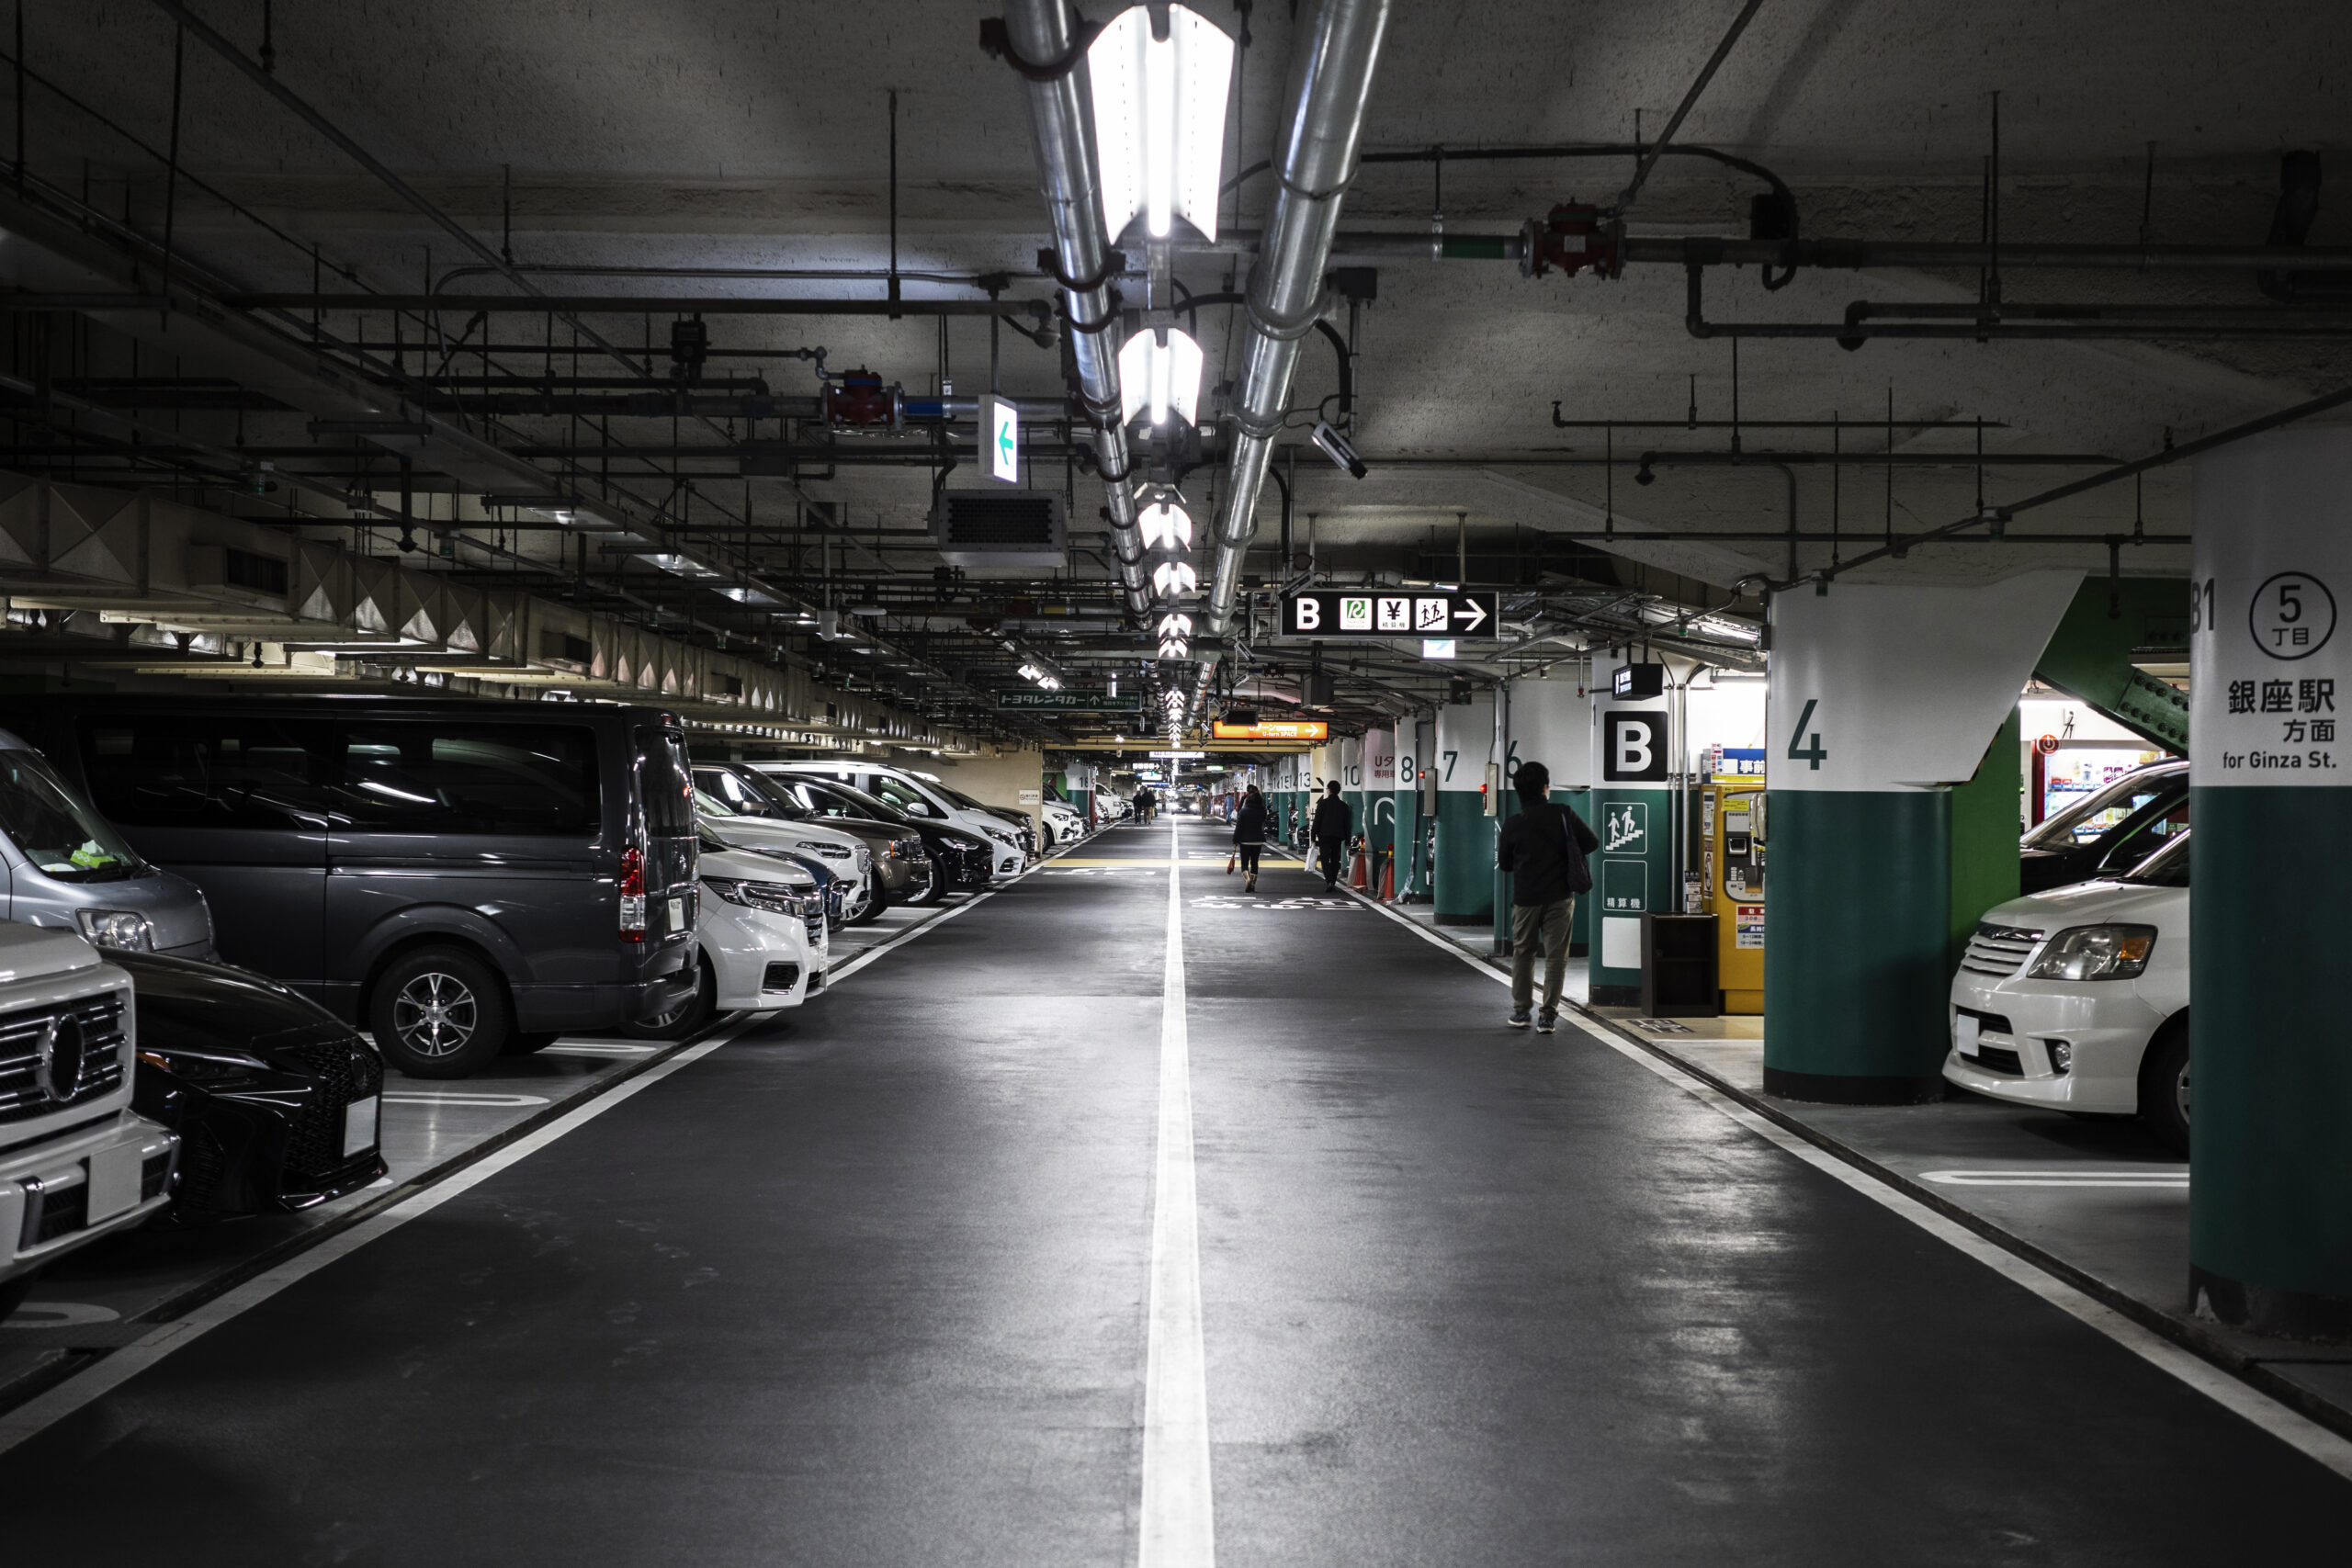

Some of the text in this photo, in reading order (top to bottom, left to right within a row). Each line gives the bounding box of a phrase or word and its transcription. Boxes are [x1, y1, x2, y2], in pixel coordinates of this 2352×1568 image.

[1297, 598, 1320, 629] B
[2192, 578, 2214, 634] B1
[2279, 584, 2301, 623] 5
[2272, 627, 2309, 647] 丁目
[1001, 694, 1086, 705] トヨタレンタカー
[2228, 678, 2335, 715] 銀座駅
[1787, 698, 1827, 771] 4
[2283, 718, 2335, 743] 方面
[1506, 739, 1522, 779] 6
[1616, 721, 1652, 773] B
[2222, 750, 2337, 769] for Ginza St.
[1300, 772, 1310, 787] 13
[1344, 765, 1360, 786] 10
[1401, 756, 1414, 783] 8
[1443, 750, 1458, 783] 7
[1606, 897, 1641, 908] 精算機
